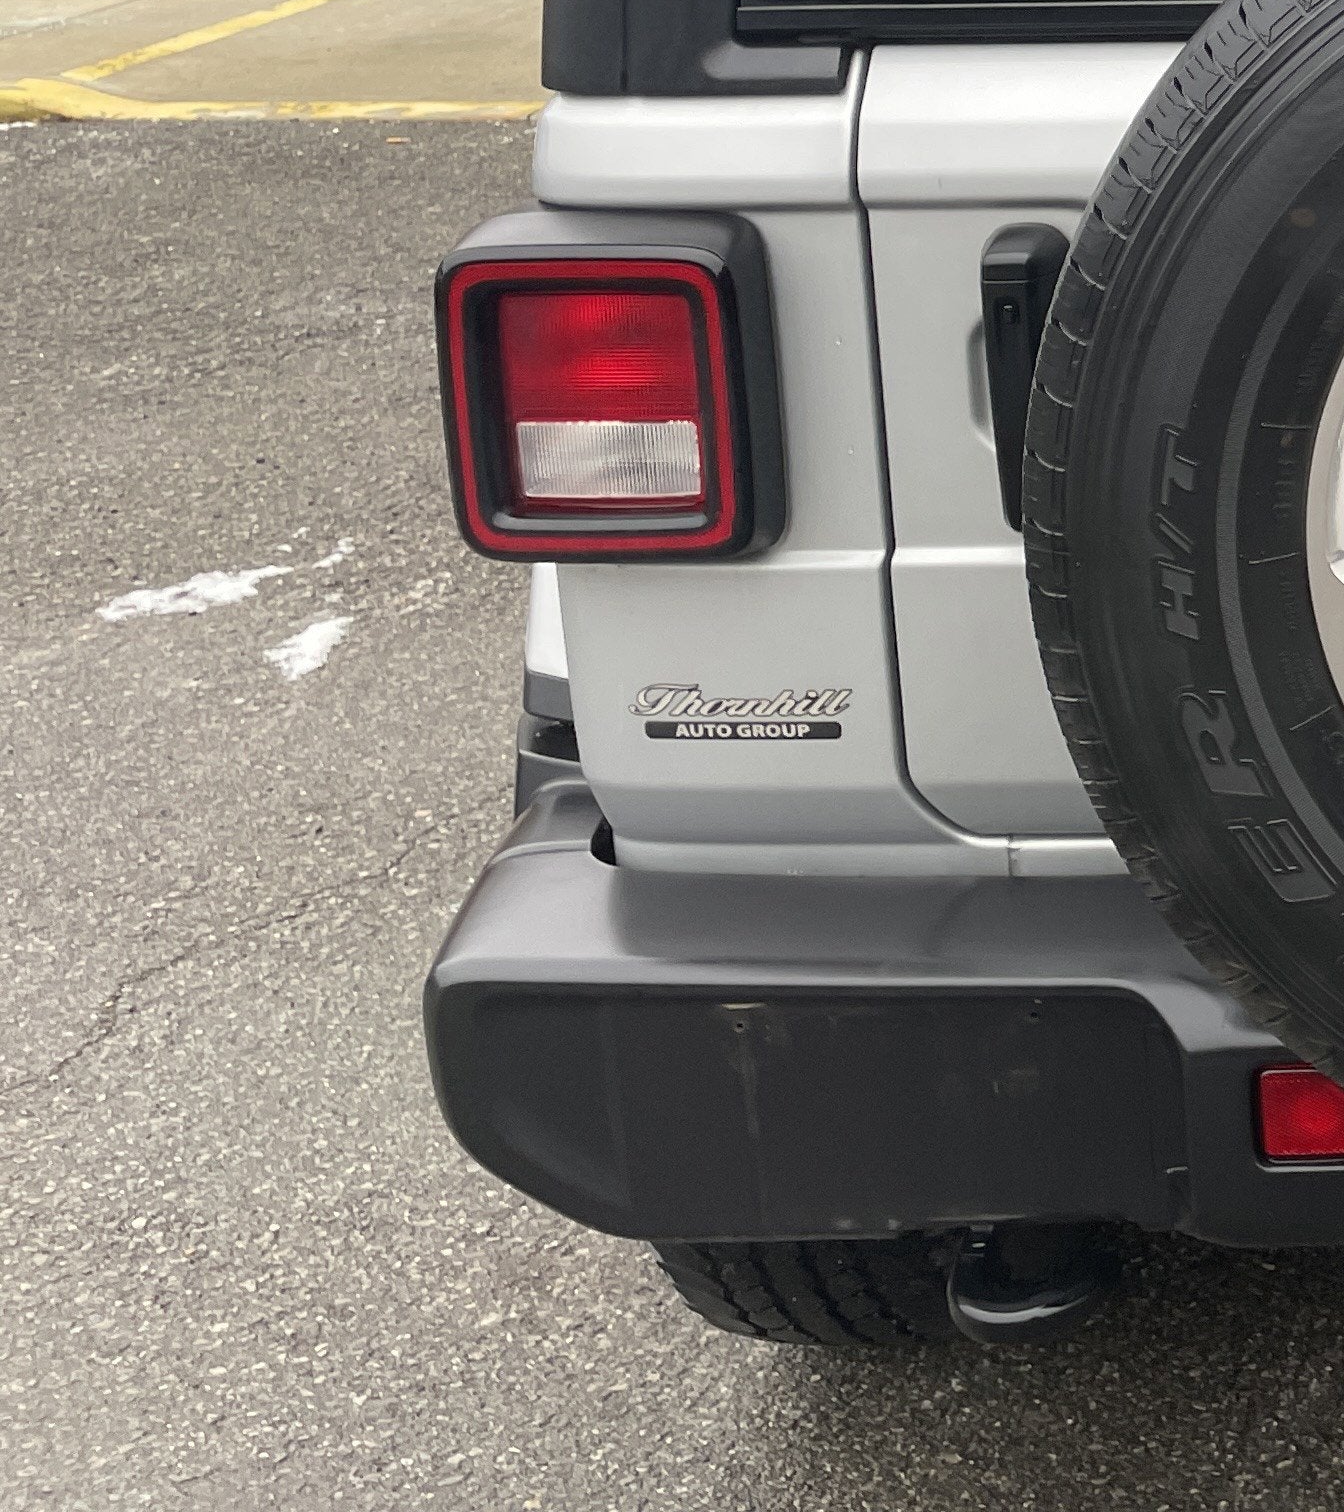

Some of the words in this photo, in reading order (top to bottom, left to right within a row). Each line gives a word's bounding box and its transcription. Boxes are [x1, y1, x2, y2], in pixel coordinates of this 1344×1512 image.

[628, 683, 853, 718] Thornhill
[675, 723, 733, 739] AUTO
[735, 723, 811, 739] GROUP
